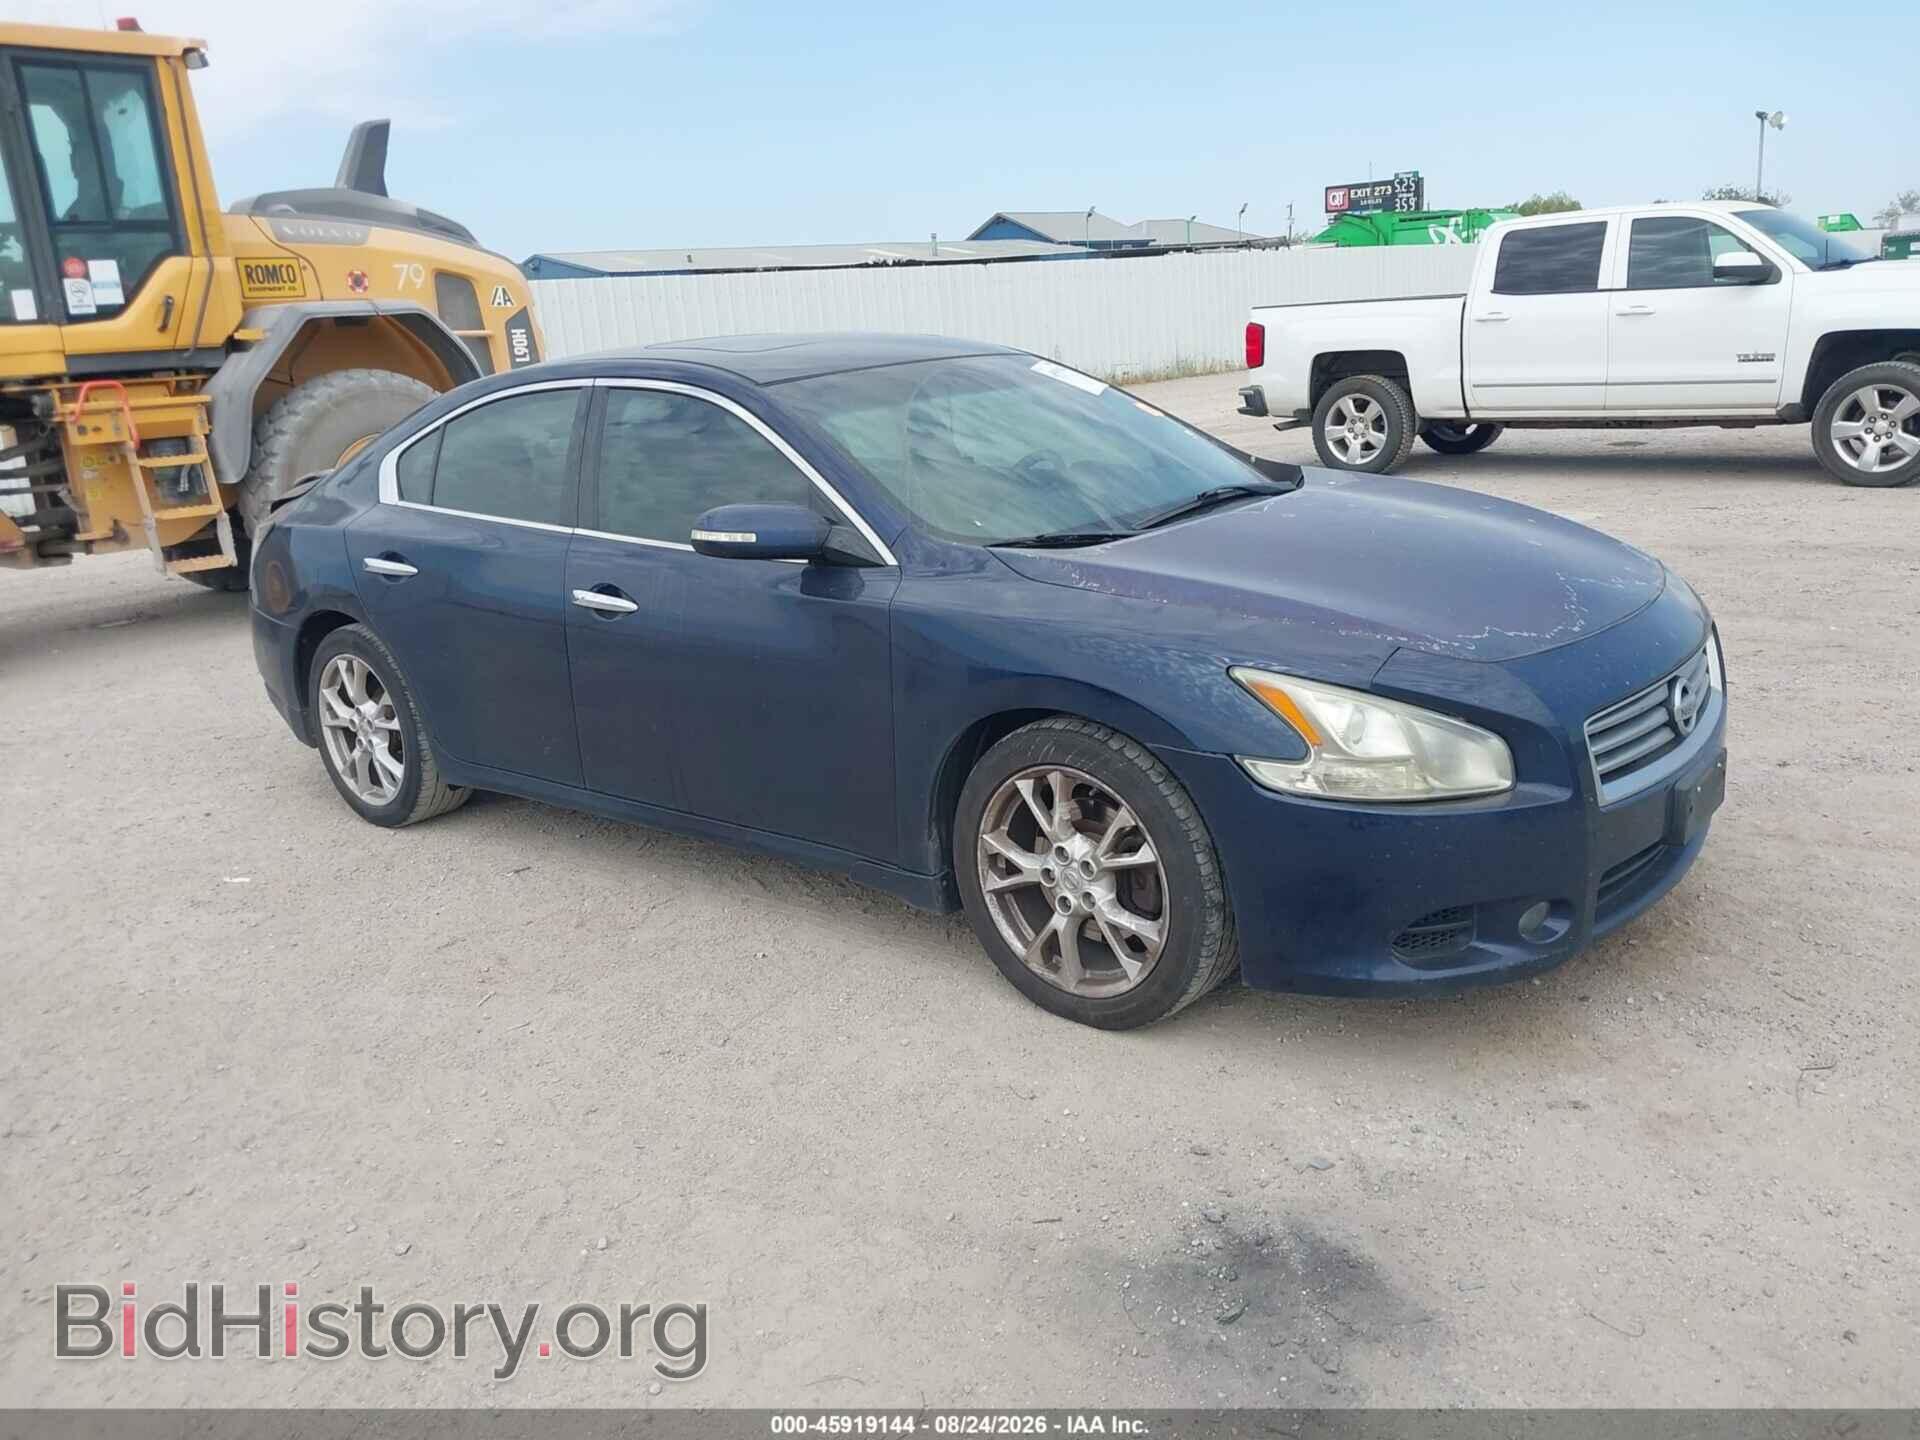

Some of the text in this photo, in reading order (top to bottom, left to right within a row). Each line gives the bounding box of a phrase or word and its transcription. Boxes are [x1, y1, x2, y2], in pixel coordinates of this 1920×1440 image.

[1350, 188, 1371, 198] EXIT
[1374, 185, 1392, 196] 273
[244, 264, 296, 285] ROMCO
[392, 263, 425, 291] 79
[511, 329, 530, 362] L90H
